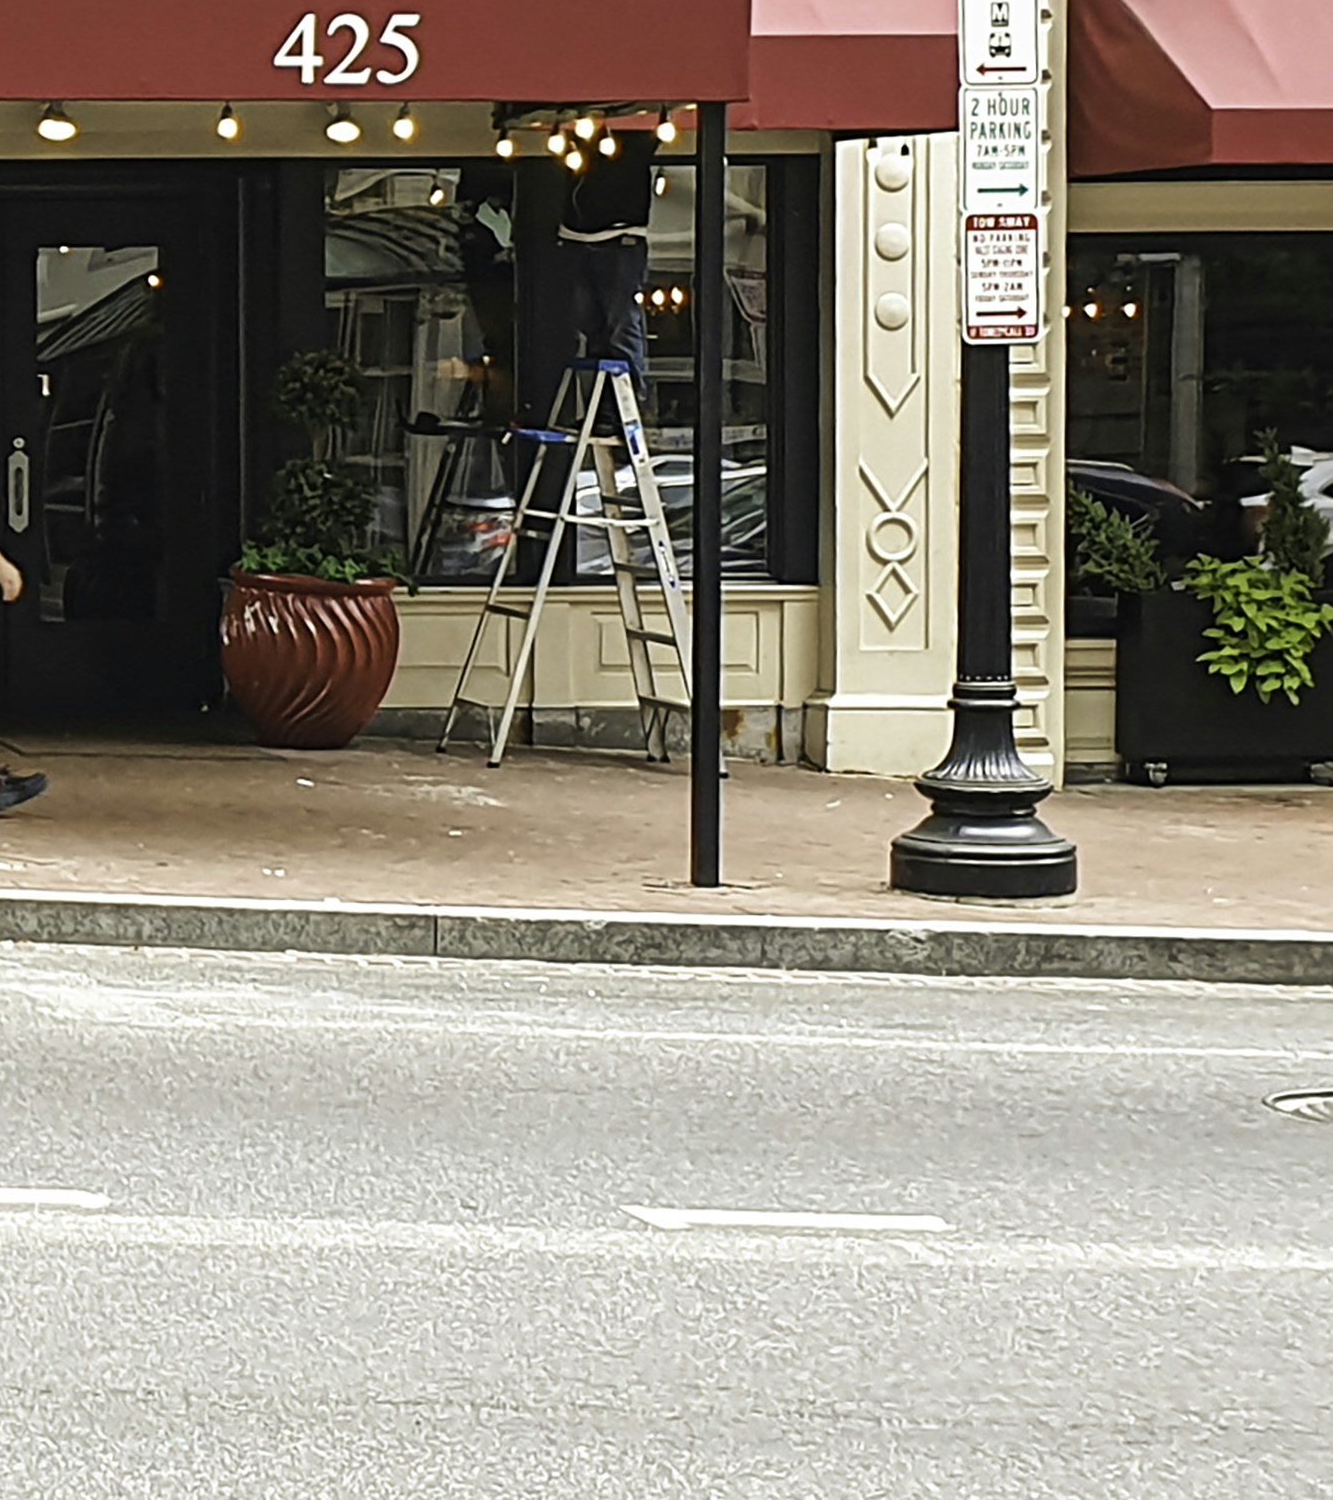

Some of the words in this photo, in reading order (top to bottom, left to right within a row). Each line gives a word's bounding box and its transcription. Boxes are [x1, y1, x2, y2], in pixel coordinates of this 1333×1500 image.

[272, 12, 421, 85] 425
[970, 97, 980, 117] 2
[986, 96, 1031, 117] HOUR
[969, 120, 1032, 141] PARKING
